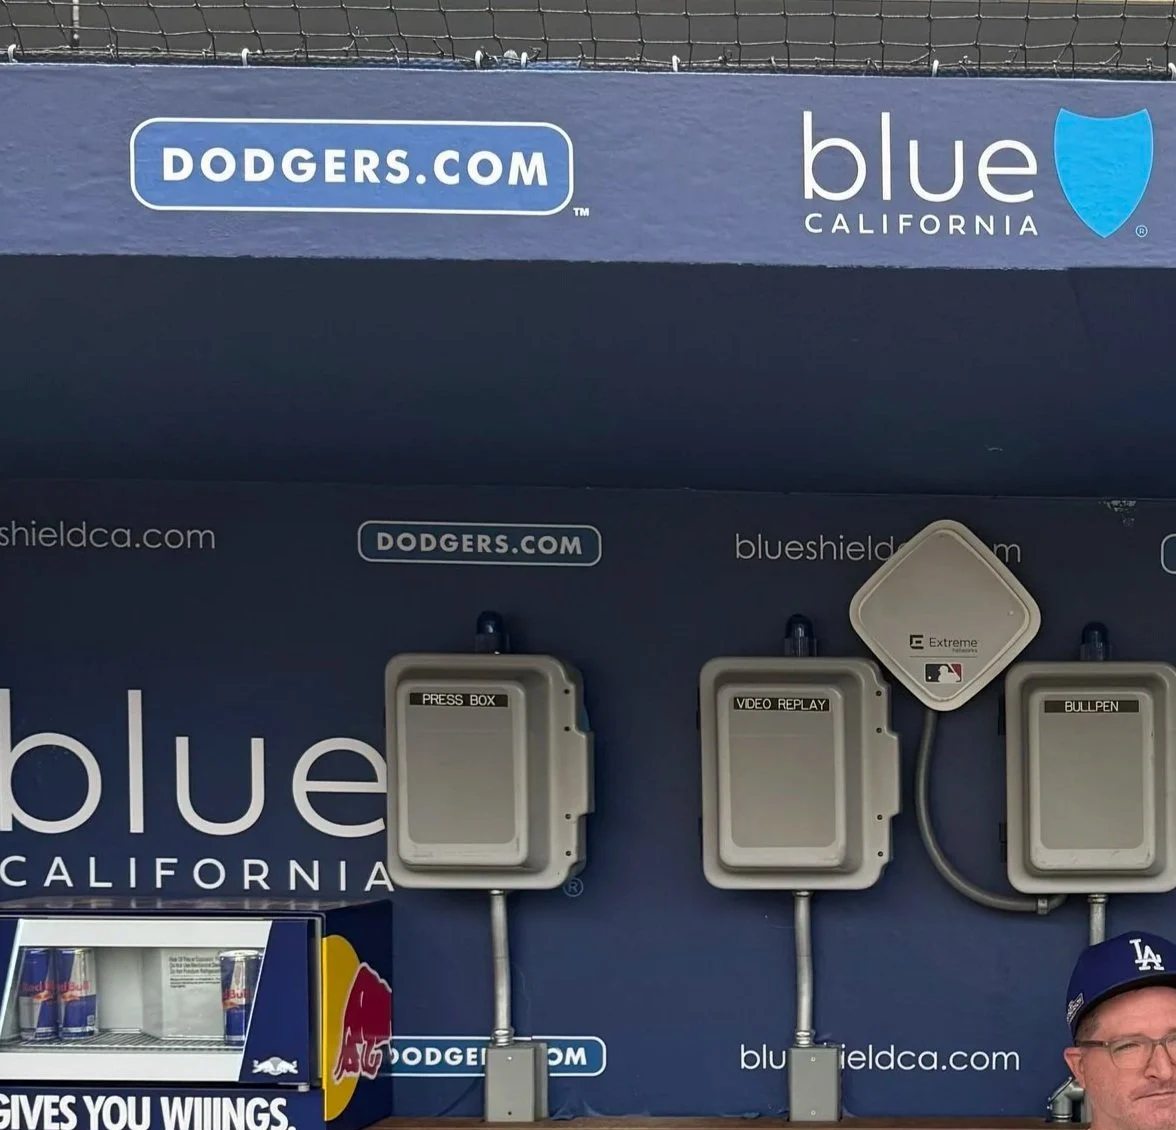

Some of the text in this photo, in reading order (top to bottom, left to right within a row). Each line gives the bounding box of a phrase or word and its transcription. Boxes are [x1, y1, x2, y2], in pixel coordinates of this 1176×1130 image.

[162, 147, 548, 187] DODGERS.COM
[803, 110, 1038, 203] blue
[804, 212, 1038, 236] CALIFORNIA
[376, 531, 583, 556] DODGERS.COM
[929, 637, 978, 648] Extreme
[422, 693, 496, 706] PRESS BOX
[736, 698, 826, 711] VIDEO REPLAY
[1064, 700, 1119, 713] BULLPEN
[0, 688, 387, 838] blue
[0, 855, 395, 892] CALIFORNIA
[1129, 938, 1165, 971] LA
[0, 1093, 78, 1130] GIVES
